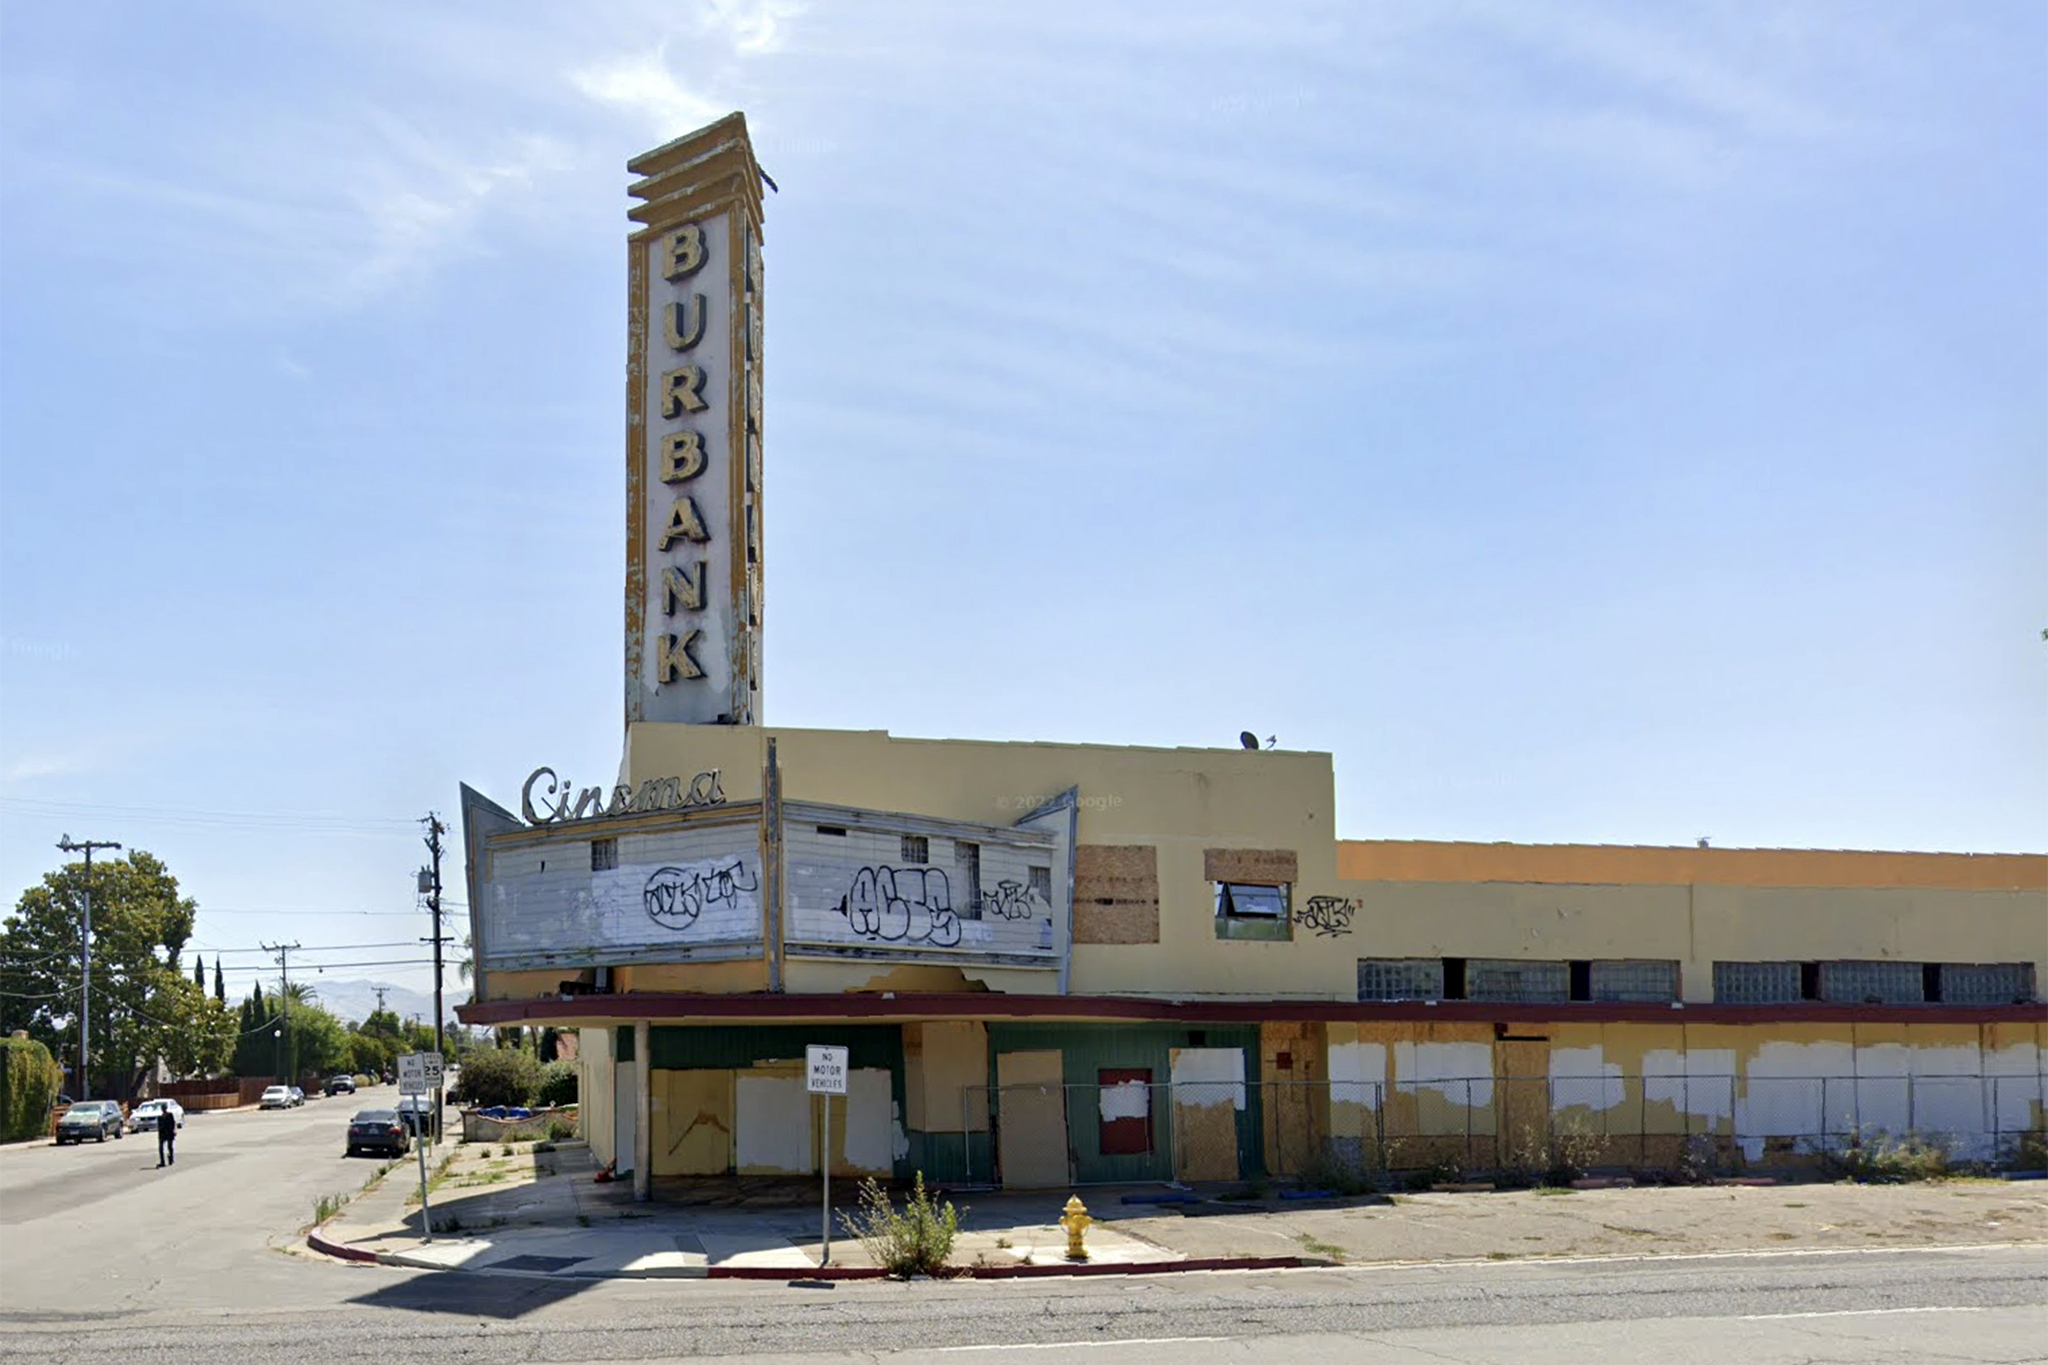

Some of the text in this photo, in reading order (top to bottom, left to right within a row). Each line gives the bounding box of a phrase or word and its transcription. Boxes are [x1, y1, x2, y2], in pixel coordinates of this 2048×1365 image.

[657, 222, 710, 685] BURBANK
[521, 766, 727, 826] Cinema
[822, 1052, 833, 1062] NO
[425, 1065, 440, 1076] 25
[814, 1065, 841, 1075] MOTOR
[811, 1078, 842, 1088] VEHICLES
